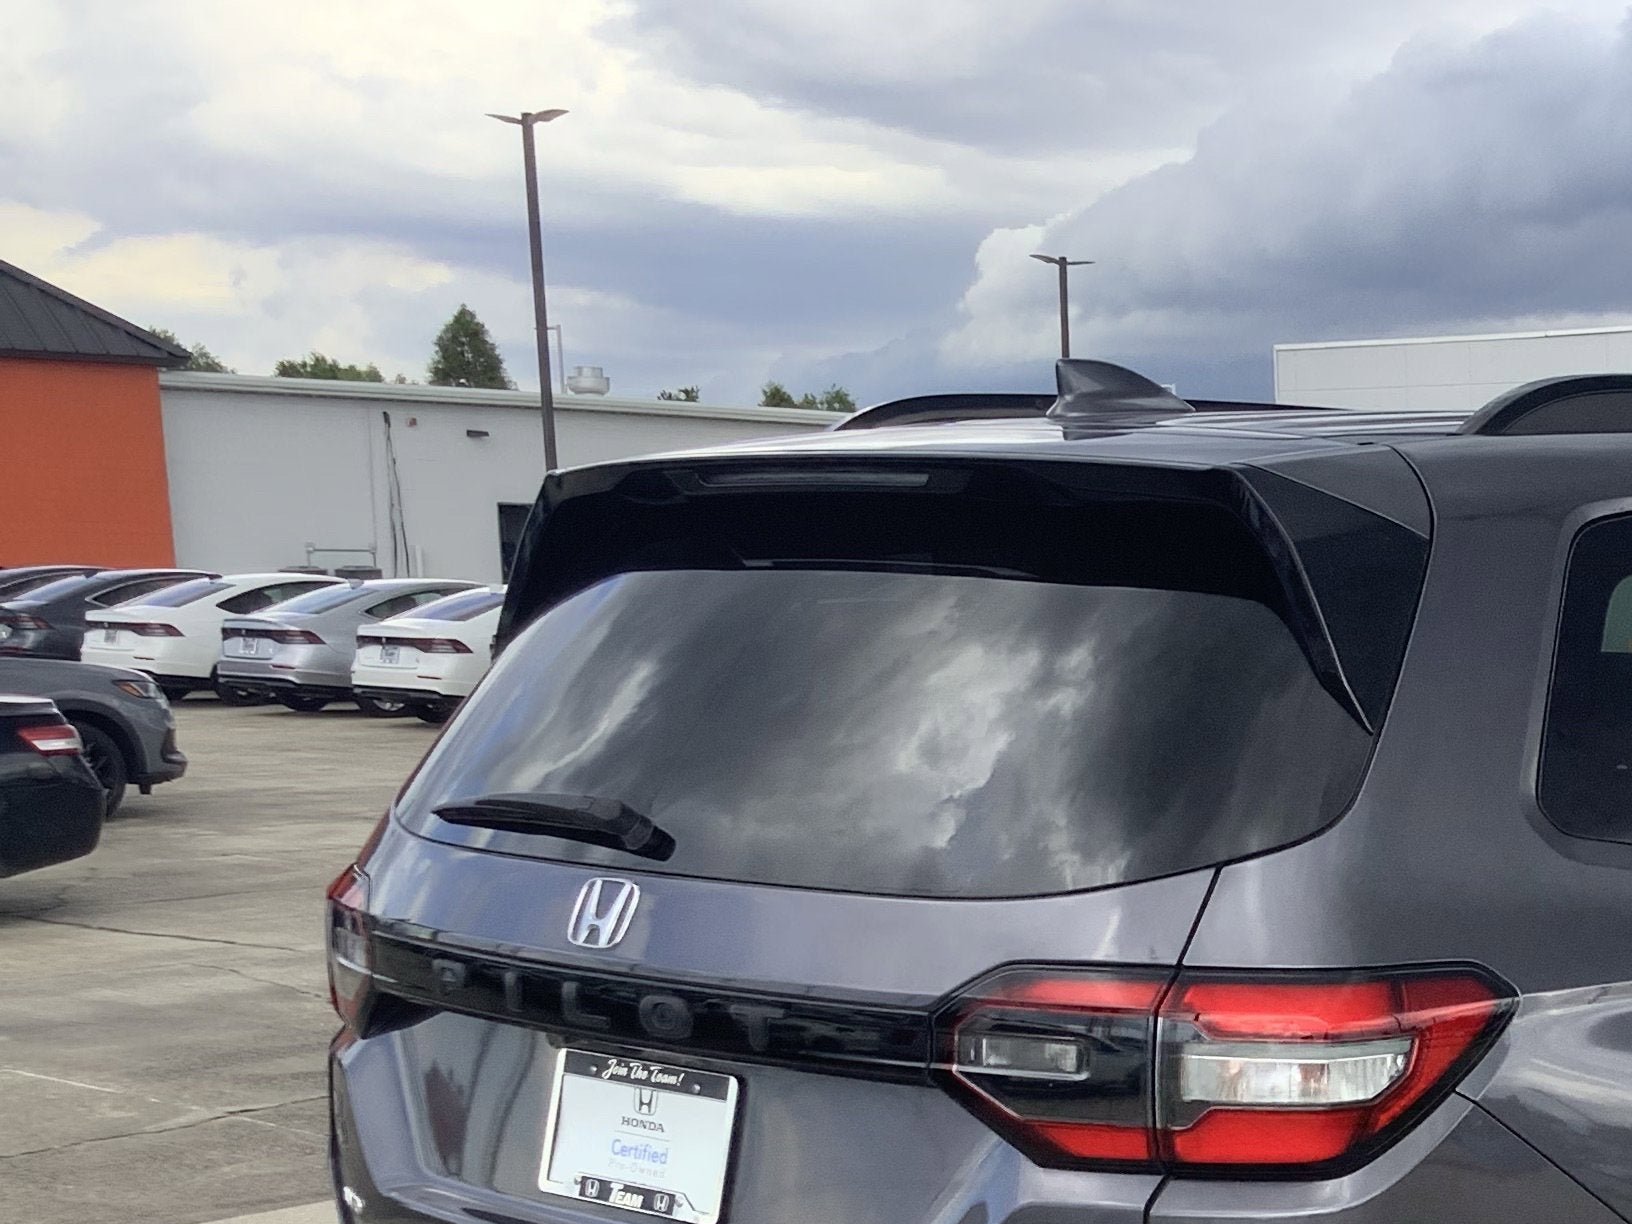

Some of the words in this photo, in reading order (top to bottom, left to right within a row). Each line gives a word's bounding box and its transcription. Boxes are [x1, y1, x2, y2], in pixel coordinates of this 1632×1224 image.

[431, 957, 787, 1051] PILOT
[602, 1059, 628, 1080] Join
[630, 1062, 649, 1080] The
[650, 1066, 685, 1086] Team!
[620, 1116, 665, 1133] HONDA
[611, 1138, 669, 1164] Certified
